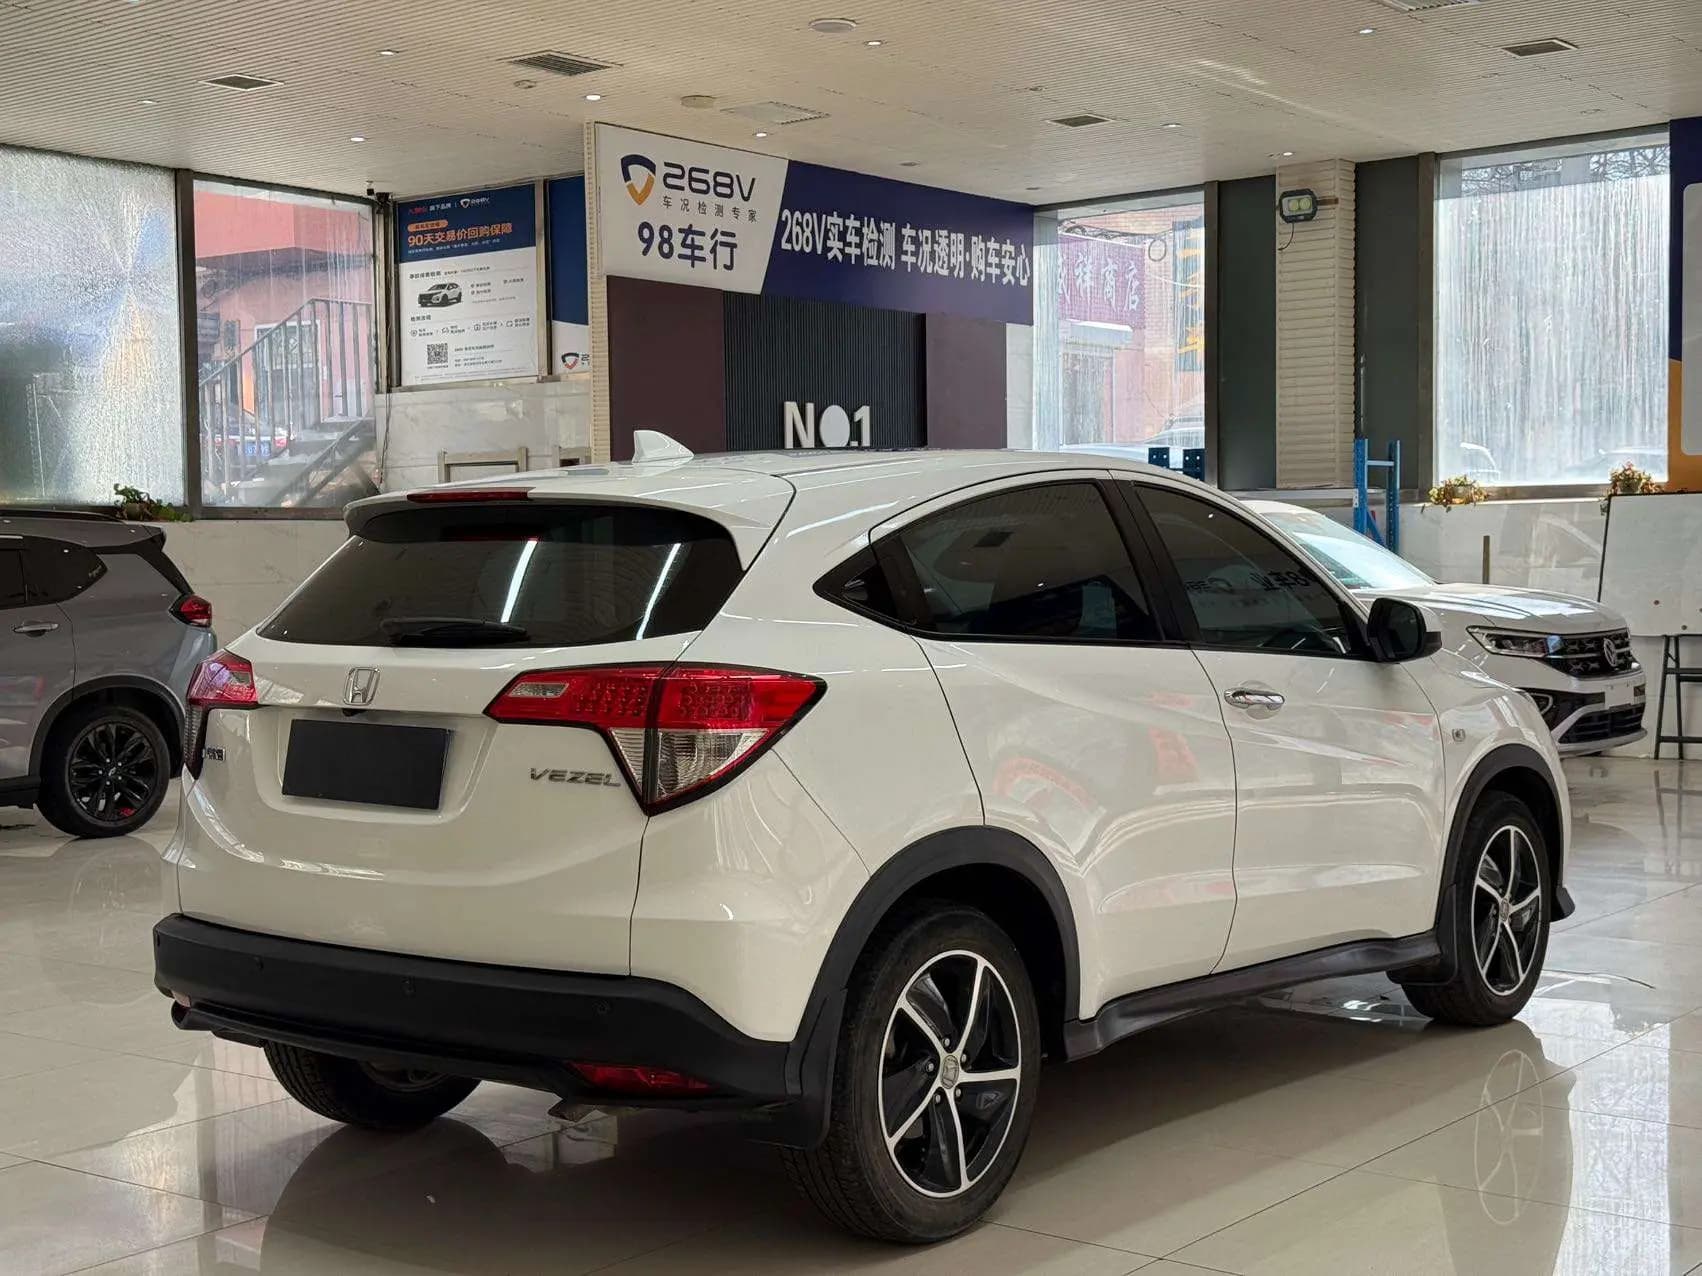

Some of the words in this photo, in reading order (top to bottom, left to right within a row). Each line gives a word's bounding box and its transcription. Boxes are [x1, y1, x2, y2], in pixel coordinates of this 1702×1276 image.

[663, 161, 756, 202] 268V
[662, 195, 758, 223] 车况检测专家
[407, 222, 513, 248] 90天交易价回购保障
[637, 220, 738, 271] 98车行
[781, 208, 896, 272] 268V实车检测
[900, 222, 1031, 287] 车况透明·购车安心
[530, 768, 621, 787] VEZEL
